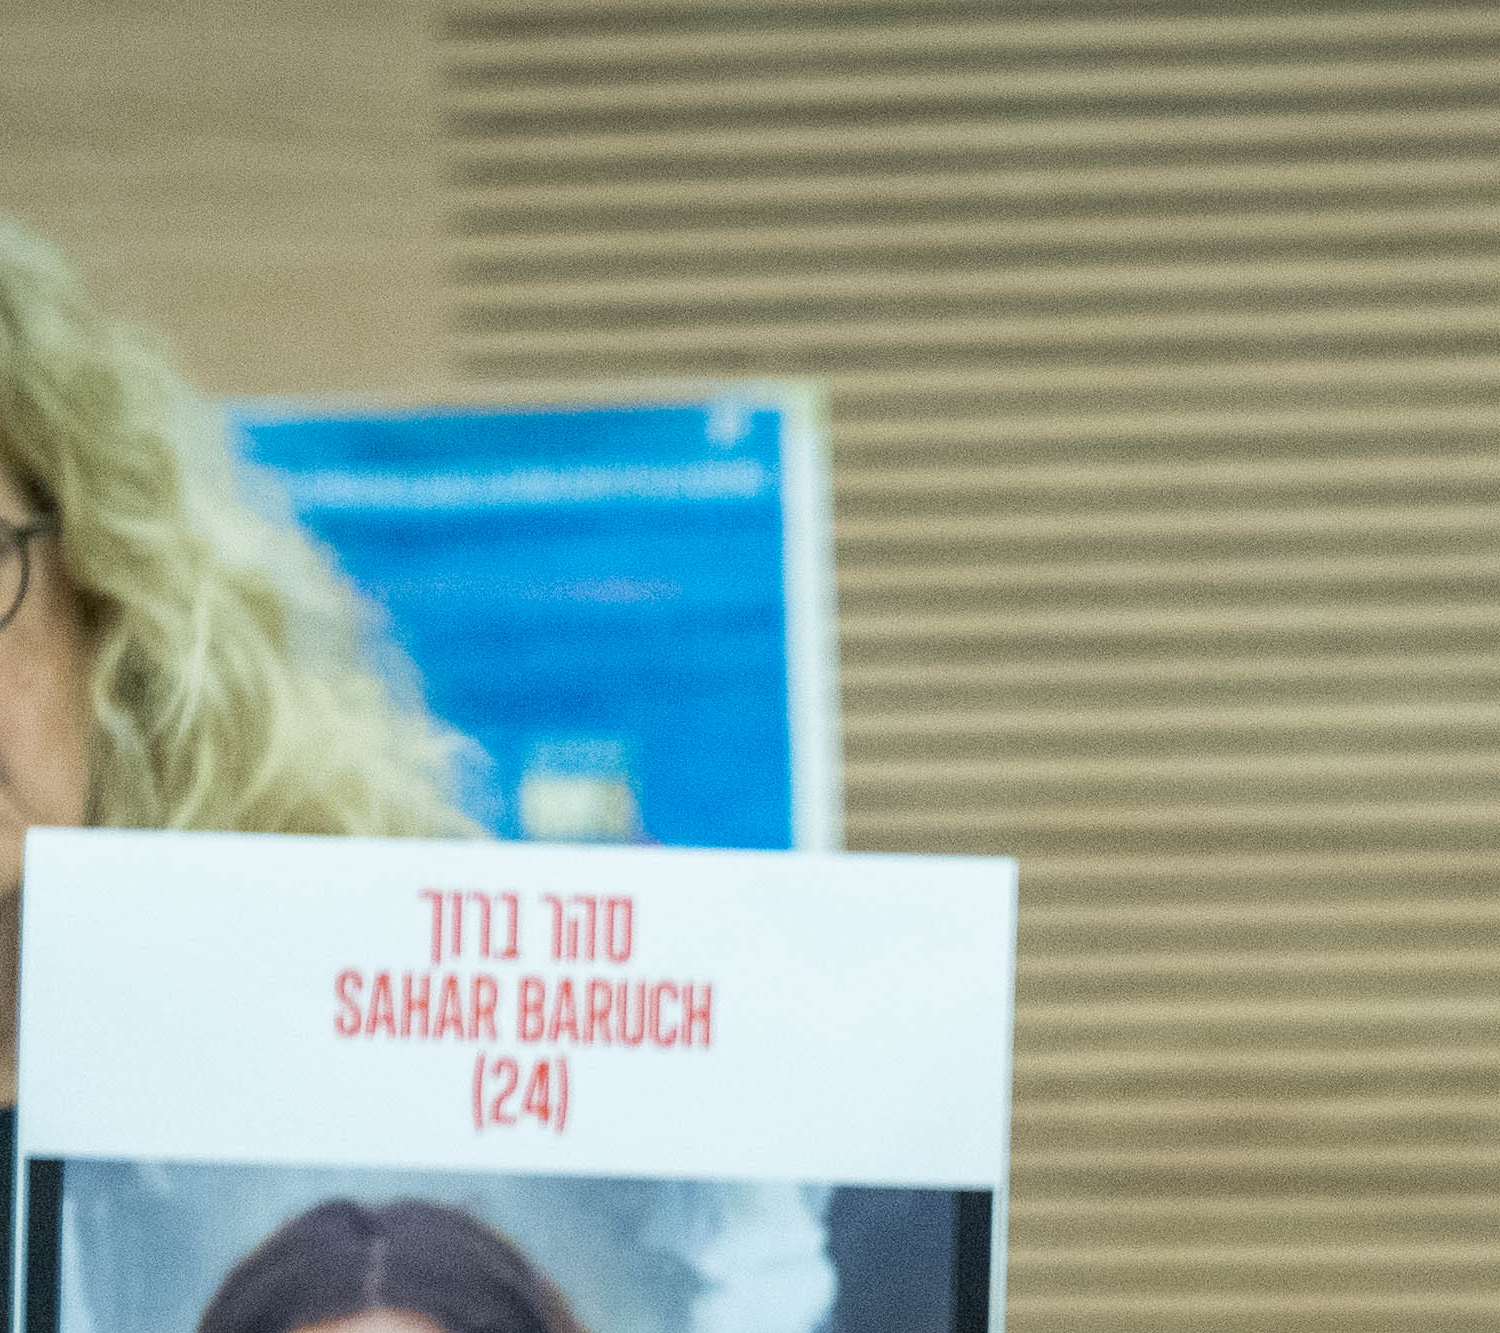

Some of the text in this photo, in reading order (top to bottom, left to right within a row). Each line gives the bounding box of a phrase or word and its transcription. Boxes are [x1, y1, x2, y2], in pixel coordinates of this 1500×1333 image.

[419, 888, 635, 966] סהר ברוך
[333, 967, 712, 1049] SAHAR BARUCH
[471, 1052, 570, 1134] (24)
